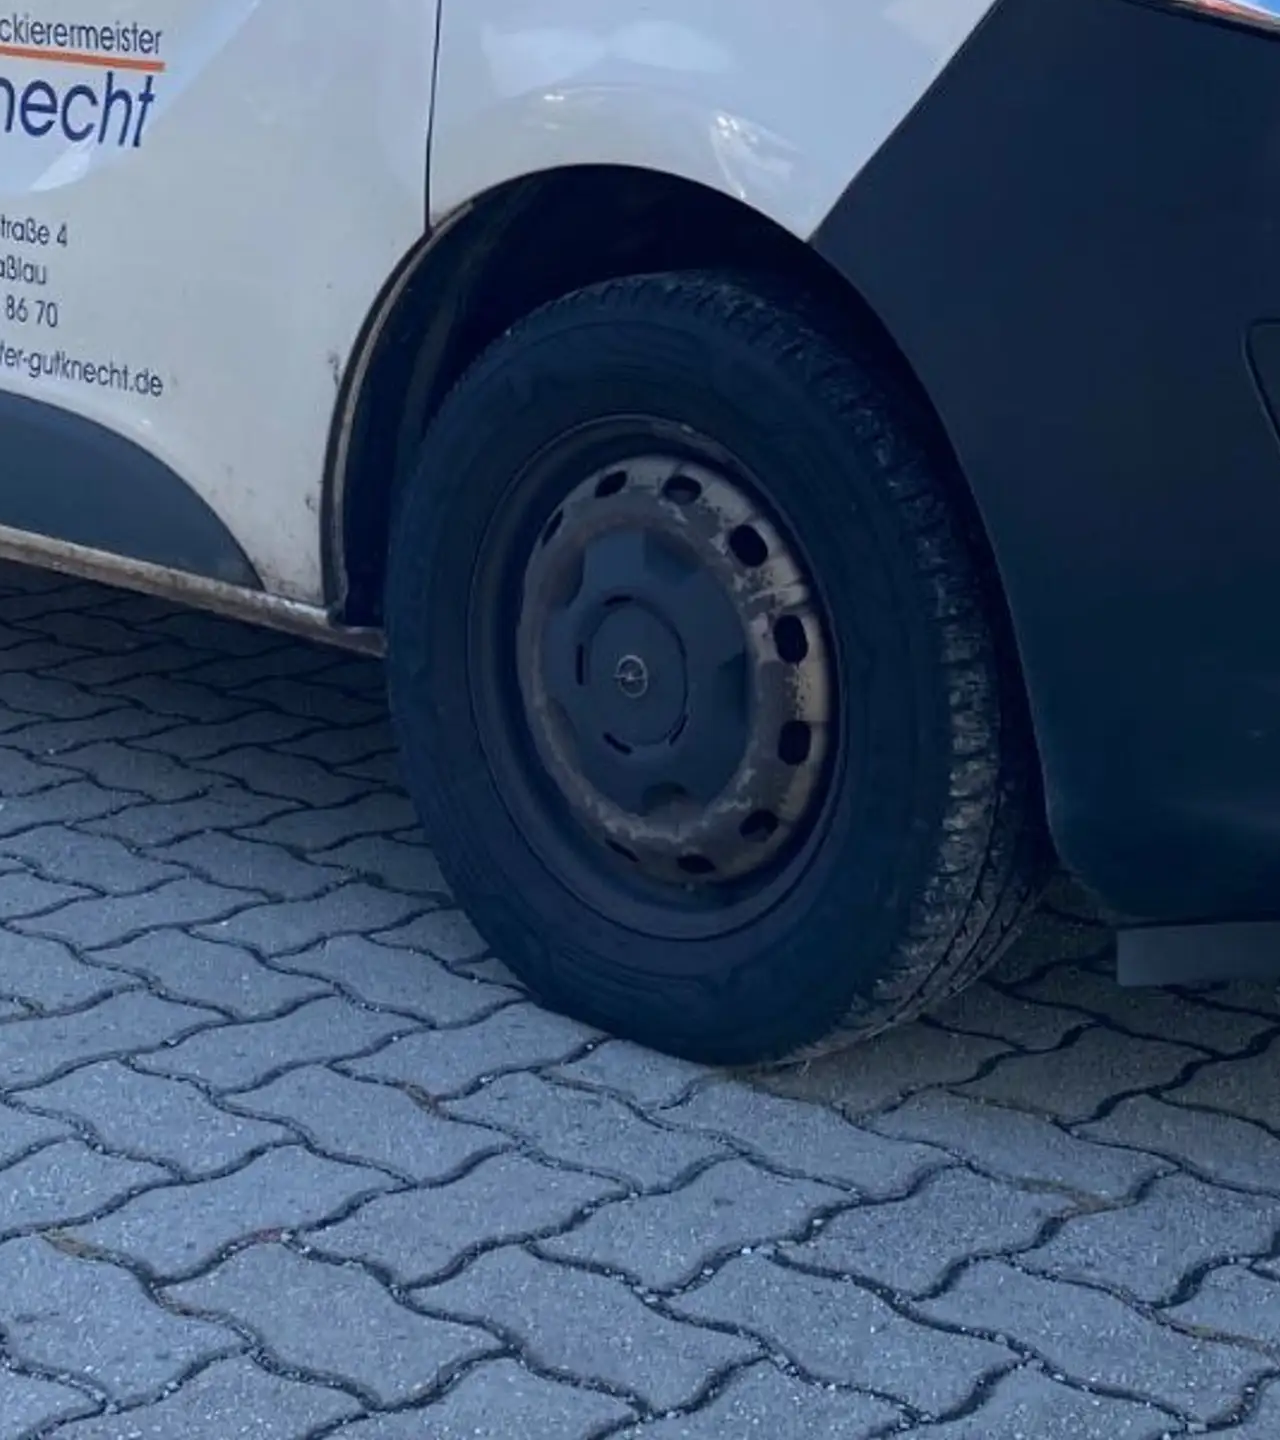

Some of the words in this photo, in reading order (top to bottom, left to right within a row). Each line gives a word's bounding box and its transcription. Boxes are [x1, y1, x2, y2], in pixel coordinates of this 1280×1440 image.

[55, 221, 69, 248] 4
[5, 294, 29, 323] 86
[35, 302, 59, 329] 70
